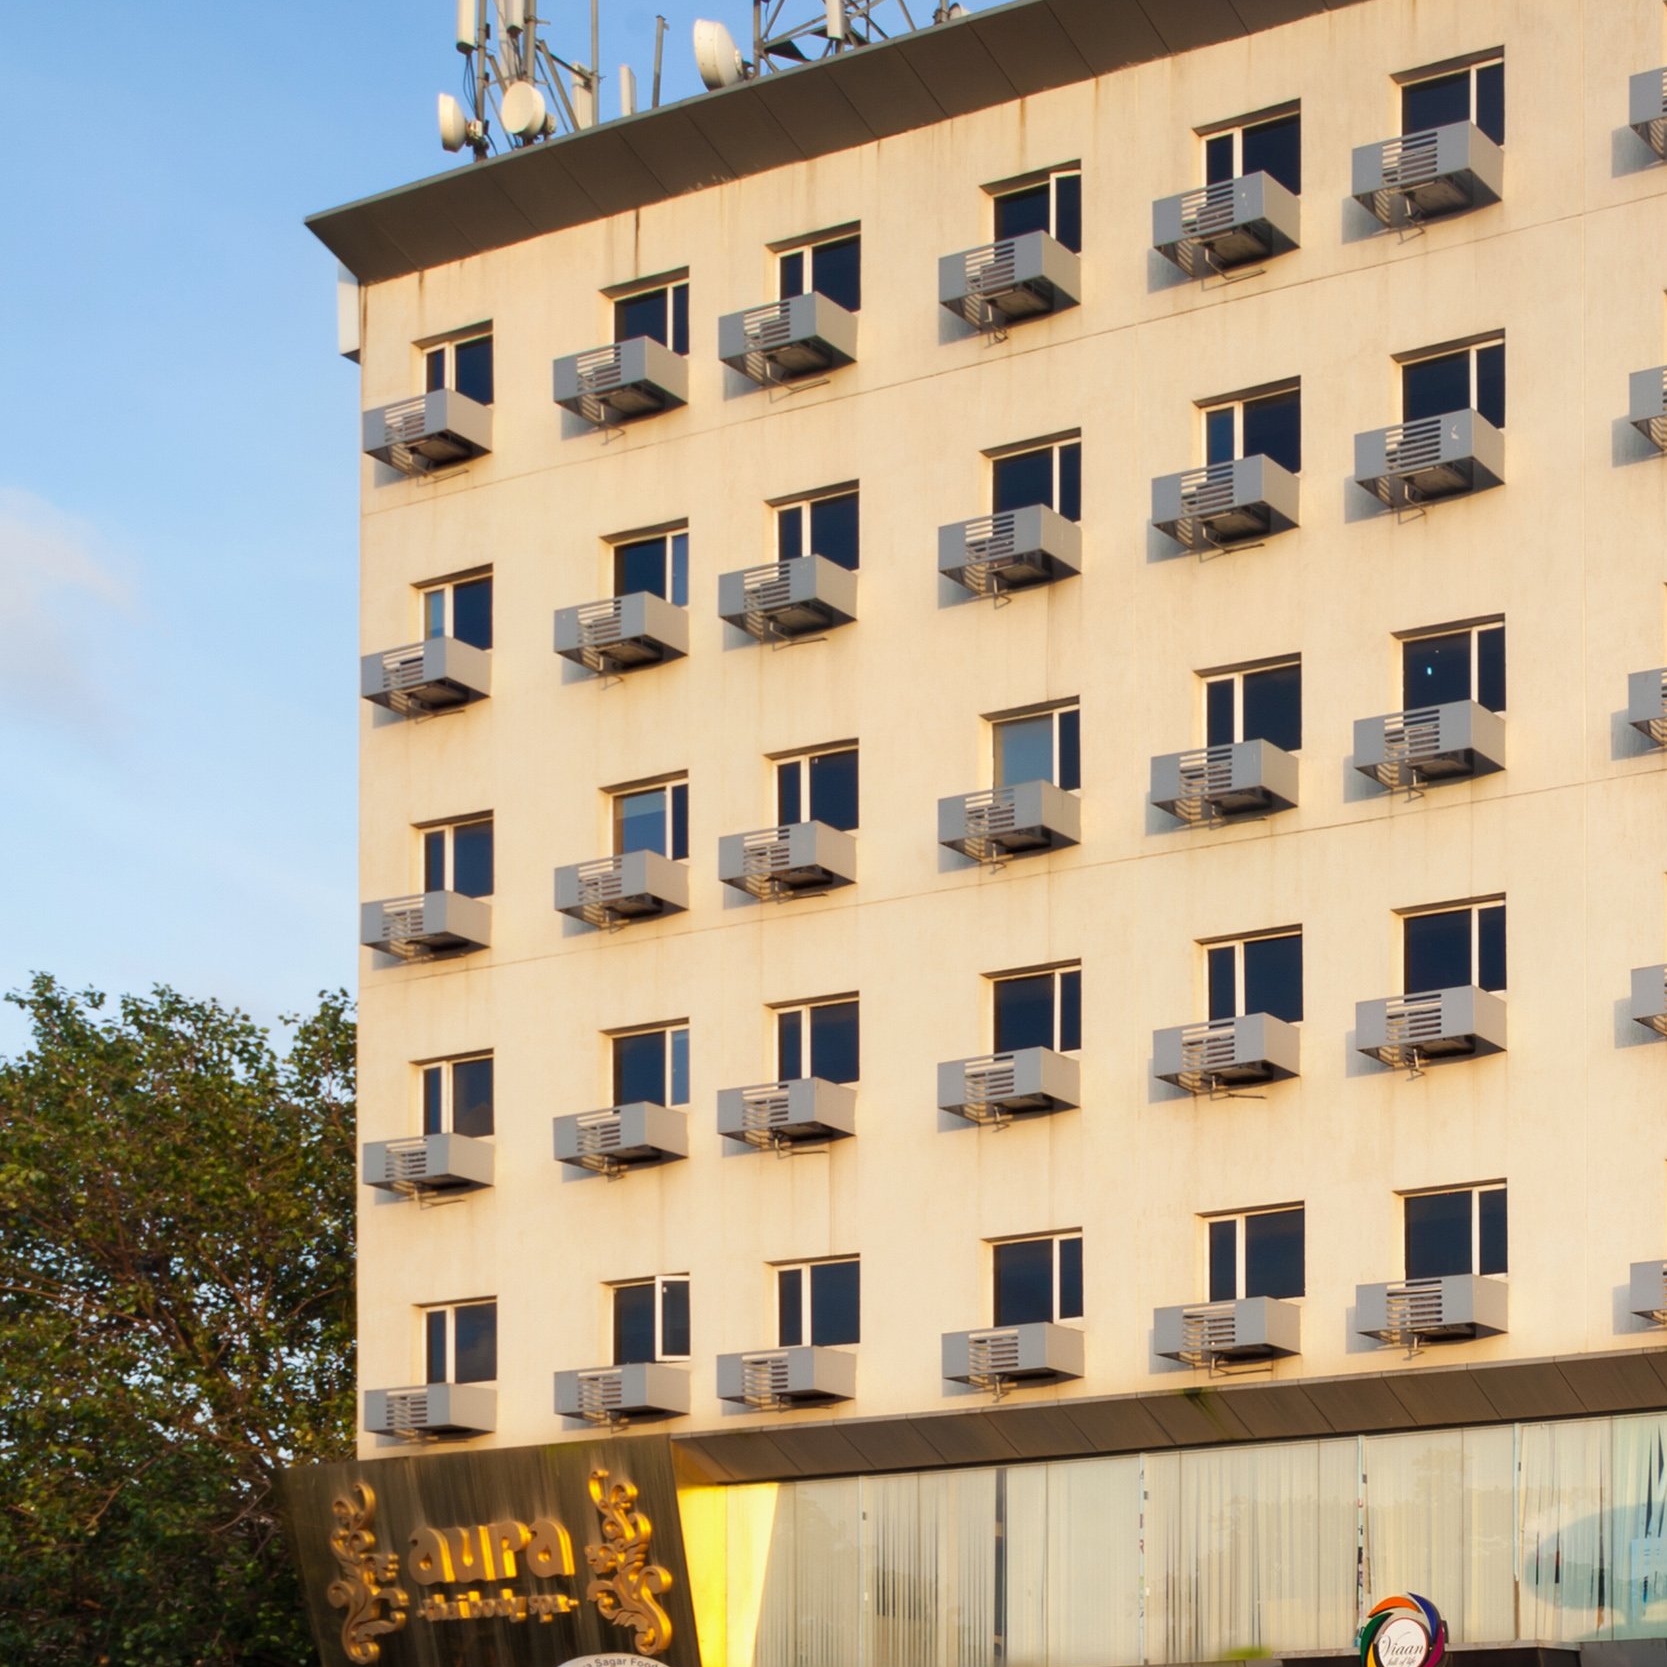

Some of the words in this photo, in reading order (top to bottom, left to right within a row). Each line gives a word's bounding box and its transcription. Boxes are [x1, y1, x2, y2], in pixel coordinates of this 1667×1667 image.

[408, 1517, 575, 1586] aura
[1379, 1632, 1424, 1656] Viaan
[594, 1658, 627, 1667] Sagar
